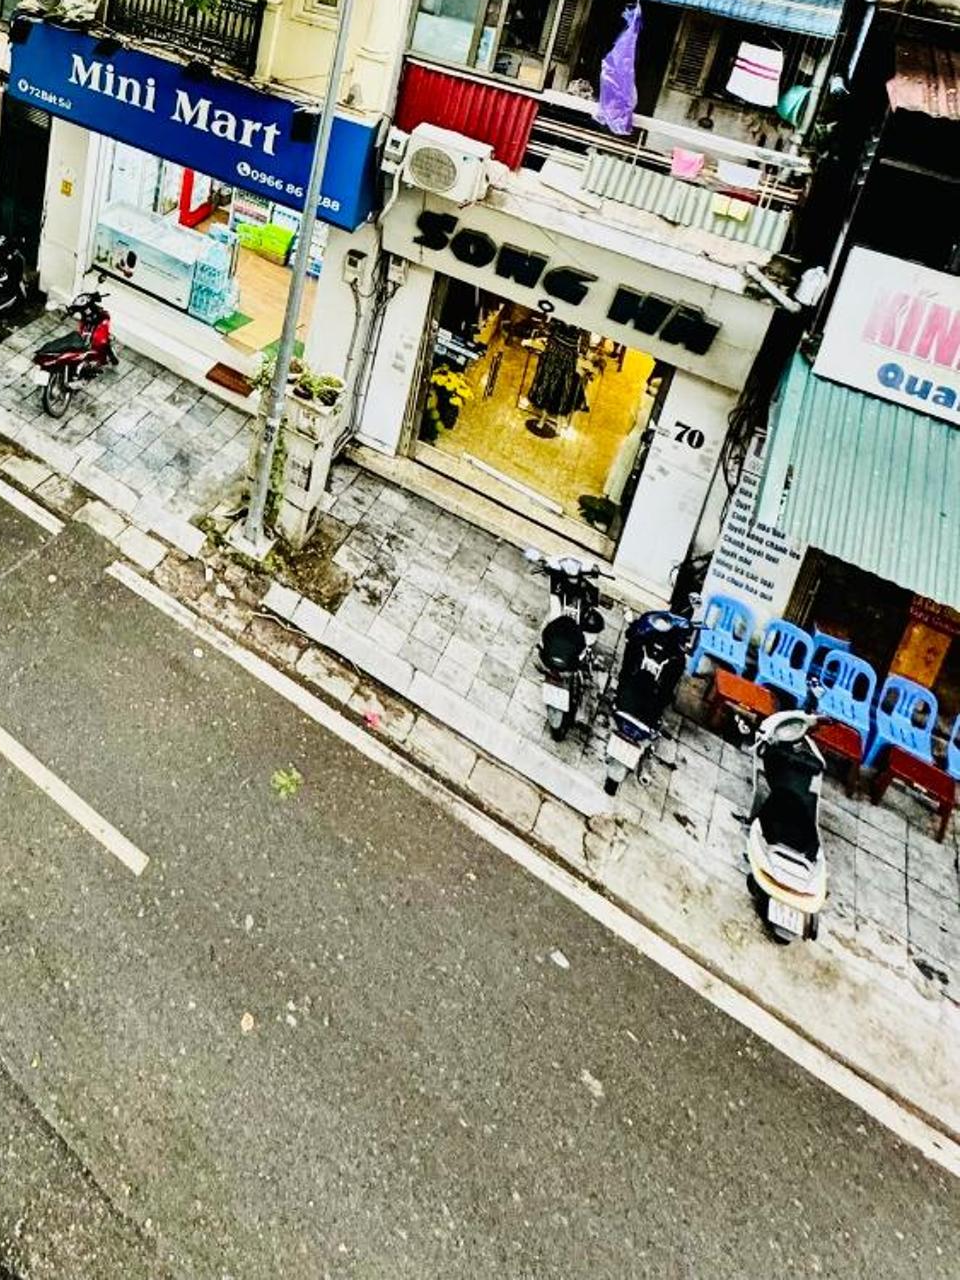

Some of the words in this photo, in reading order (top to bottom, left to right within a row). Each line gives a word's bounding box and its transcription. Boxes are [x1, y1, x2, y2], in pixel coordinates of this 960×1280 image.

[68, 53, 156, 113] Mini
[170, 89, 281, 156] Mart
[250, 170, 283, 190] 0966
[285, 183, 303, 197] 86
[413, 210, 599, 306] SONG
[862, 289, 960, 370] KIN
[877, 362, 960, 411] Qua
[674, 420, 705, 449] 70
